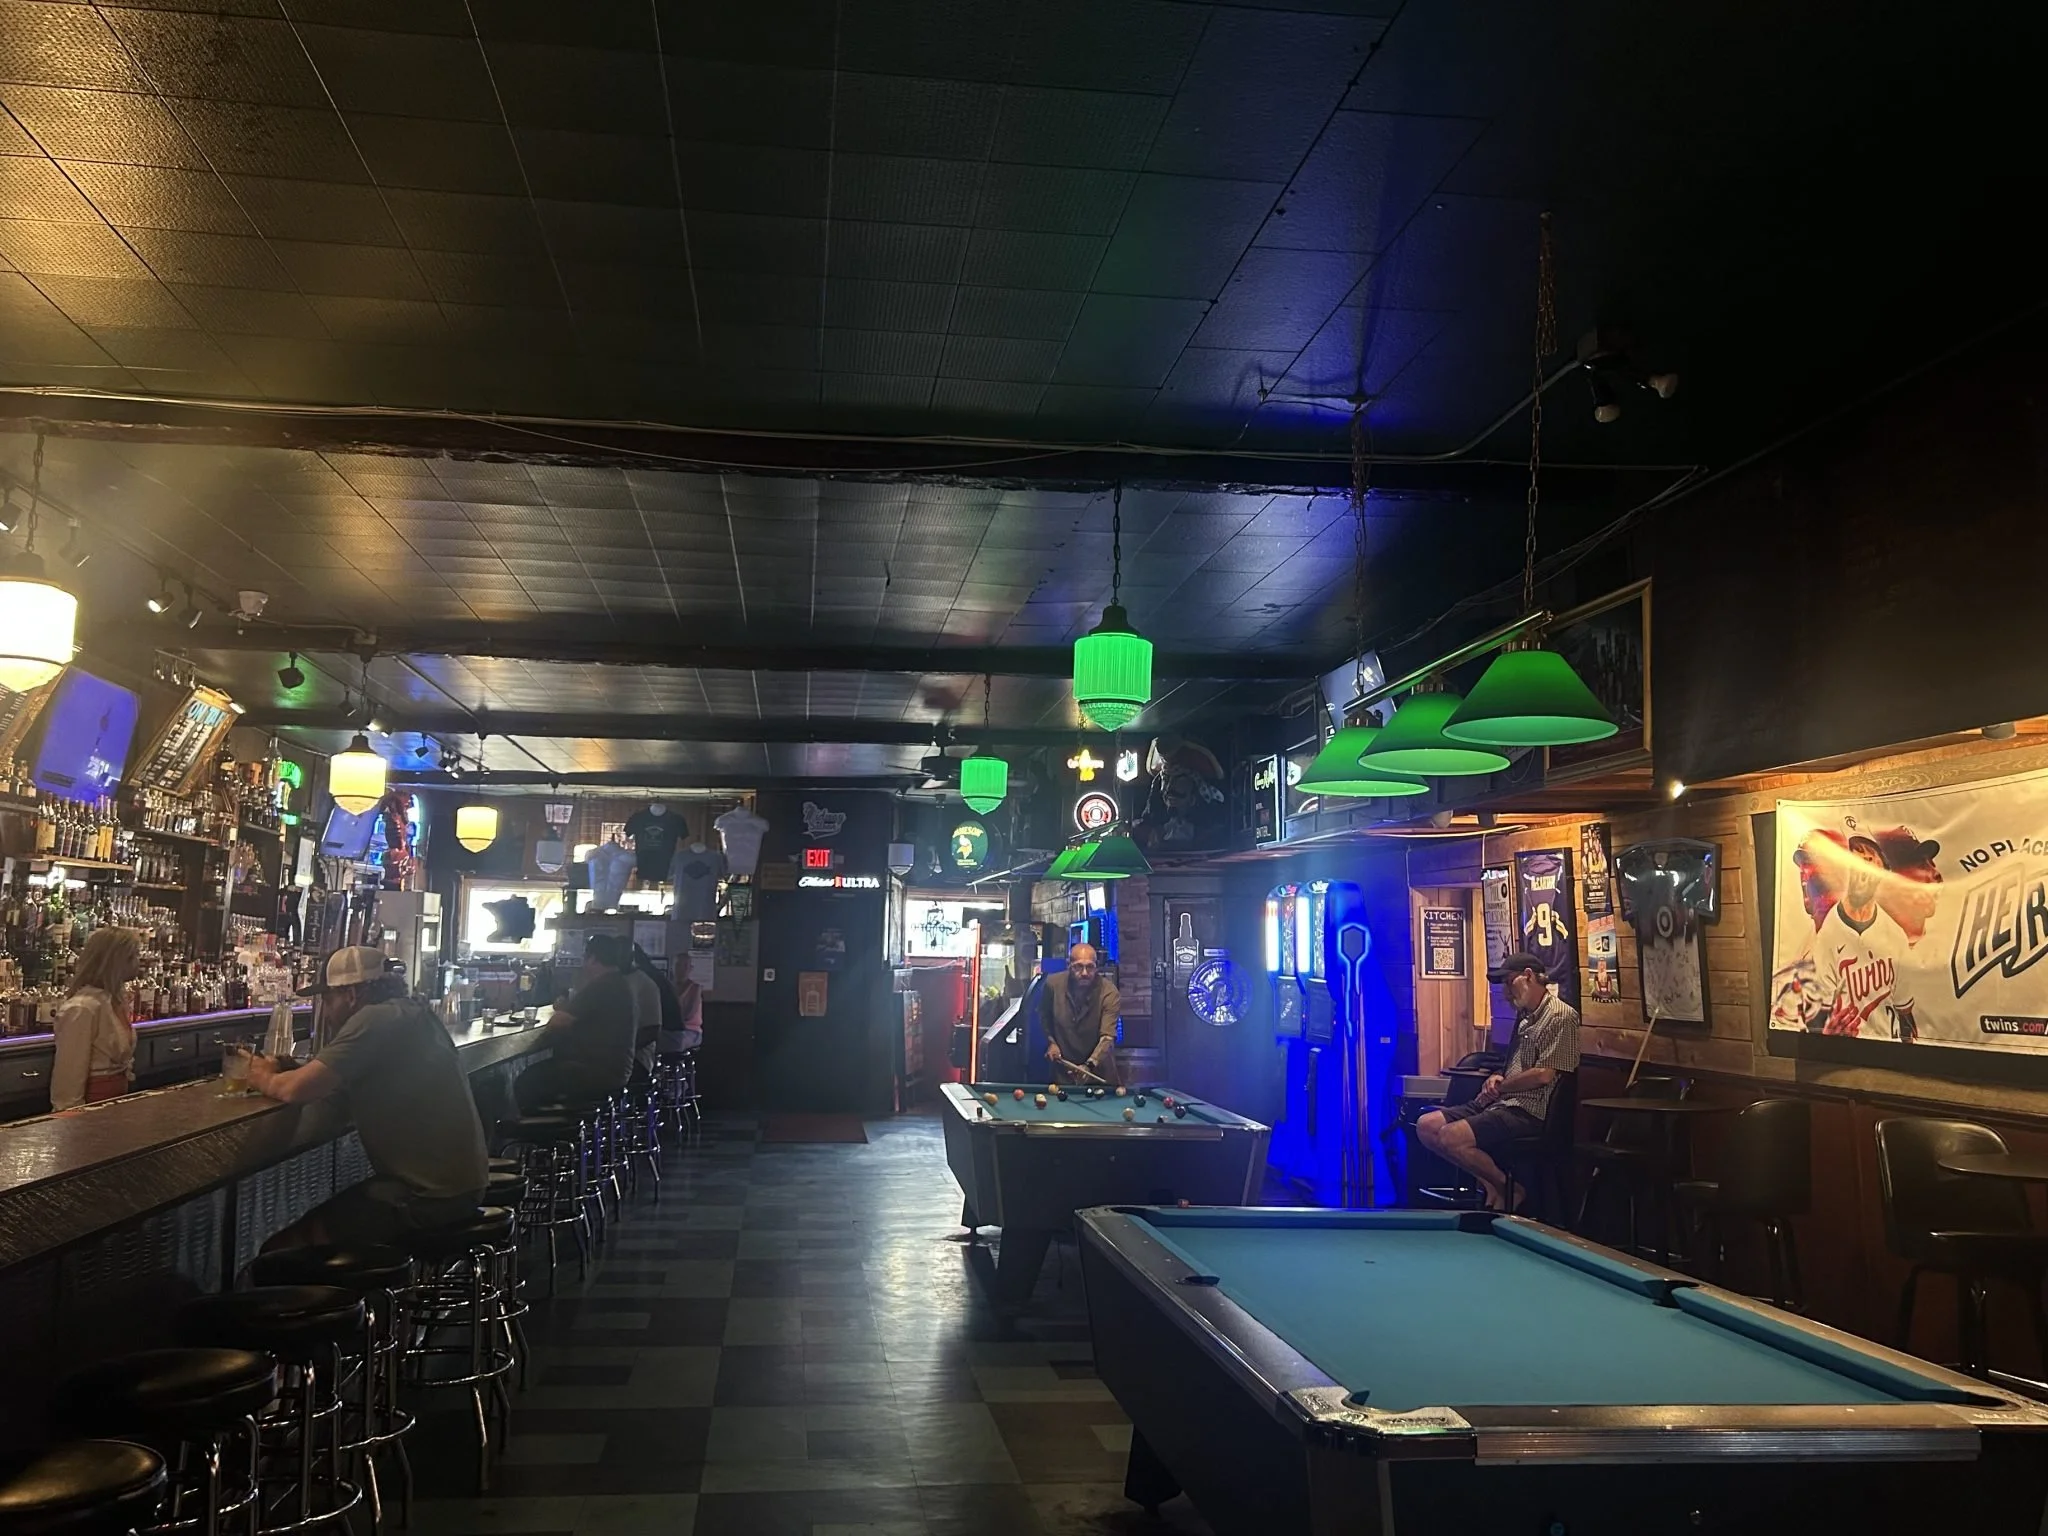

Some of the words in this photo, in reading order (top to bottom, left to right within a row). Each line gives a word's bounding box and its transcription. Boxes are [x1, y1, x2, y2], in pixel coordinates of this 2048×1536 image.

[806, 849, 830, 867] EXIT
[1959, 848, 1990, 873] NO
[842, 877, 880, 888] ULTRA
[1537, 902, 1553, 946] 9
[1839, 950, 1896, 1006] Twins
